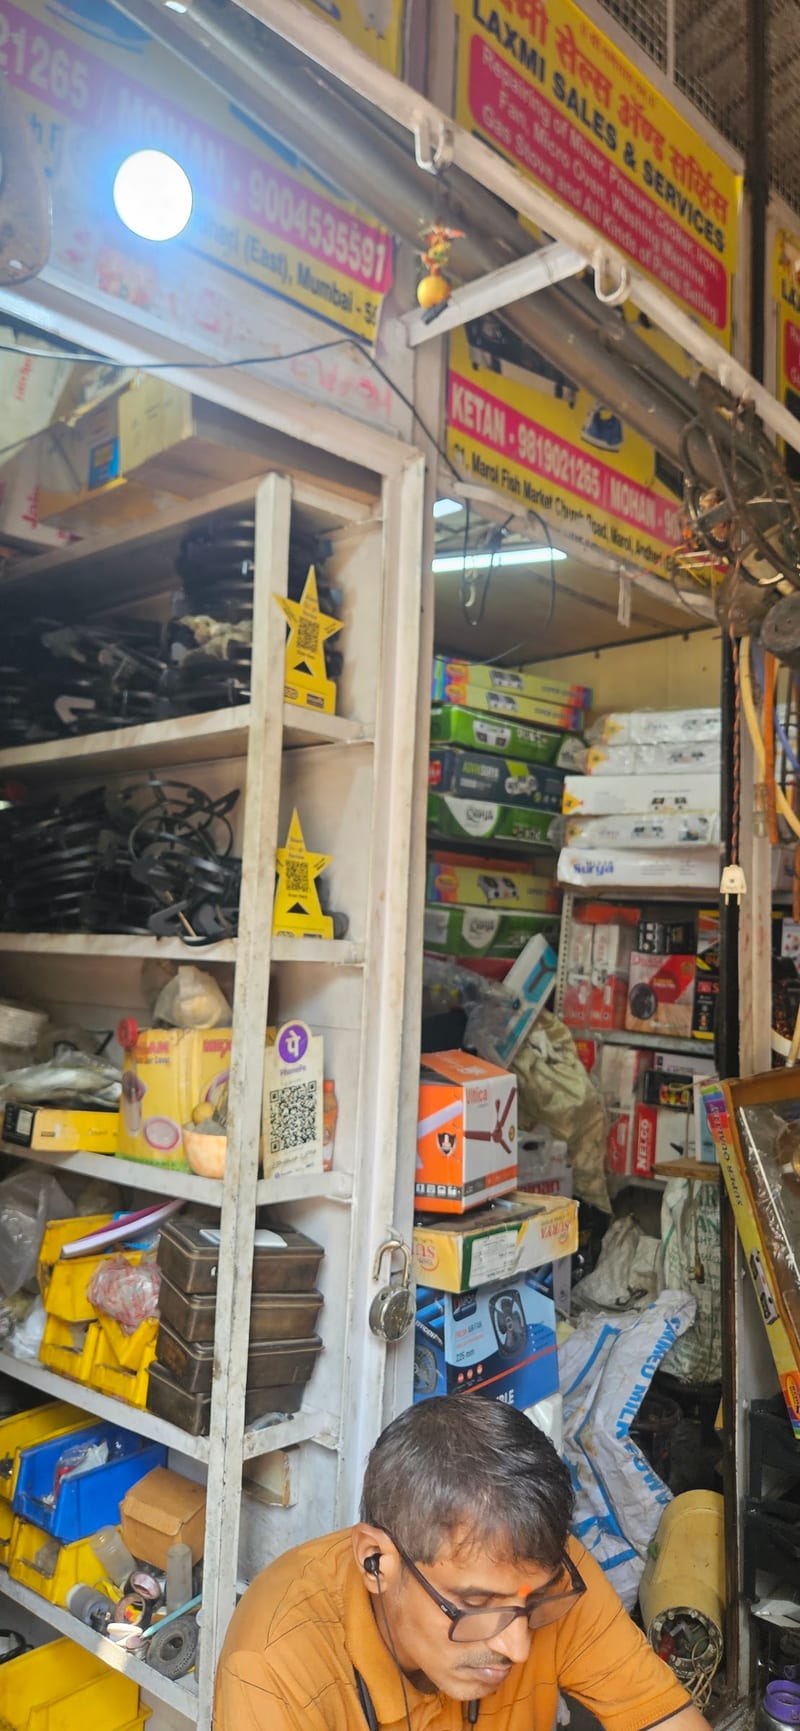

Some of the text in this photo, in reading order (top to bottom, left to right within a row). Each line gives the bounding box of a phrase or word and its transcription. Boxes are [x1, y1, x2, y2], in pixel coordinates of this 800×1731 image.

[473, 0, 546, 84] LAXMI
[551, 70, 618, 152] SALES
[622, 140, 637, 174] &
[642, 158, 725, 254] SERVICES
[482, 44, 552, 129] Repairing
[249, 169, 388, 285] 9004535591
[297, 261, 354, 314] Mumbai
[451, 381, 506, 447] KETAN
[517, 423, 600, 500] 9819021265
[610, 476, 656, 530] MOHAN
[471, 450, 498, 484] Marol
[501, 467, 521, 495] Fish
[709, 1102, 744, 1206] SUPER QUALITY
[615, 1384, 647, 1440] MILK
